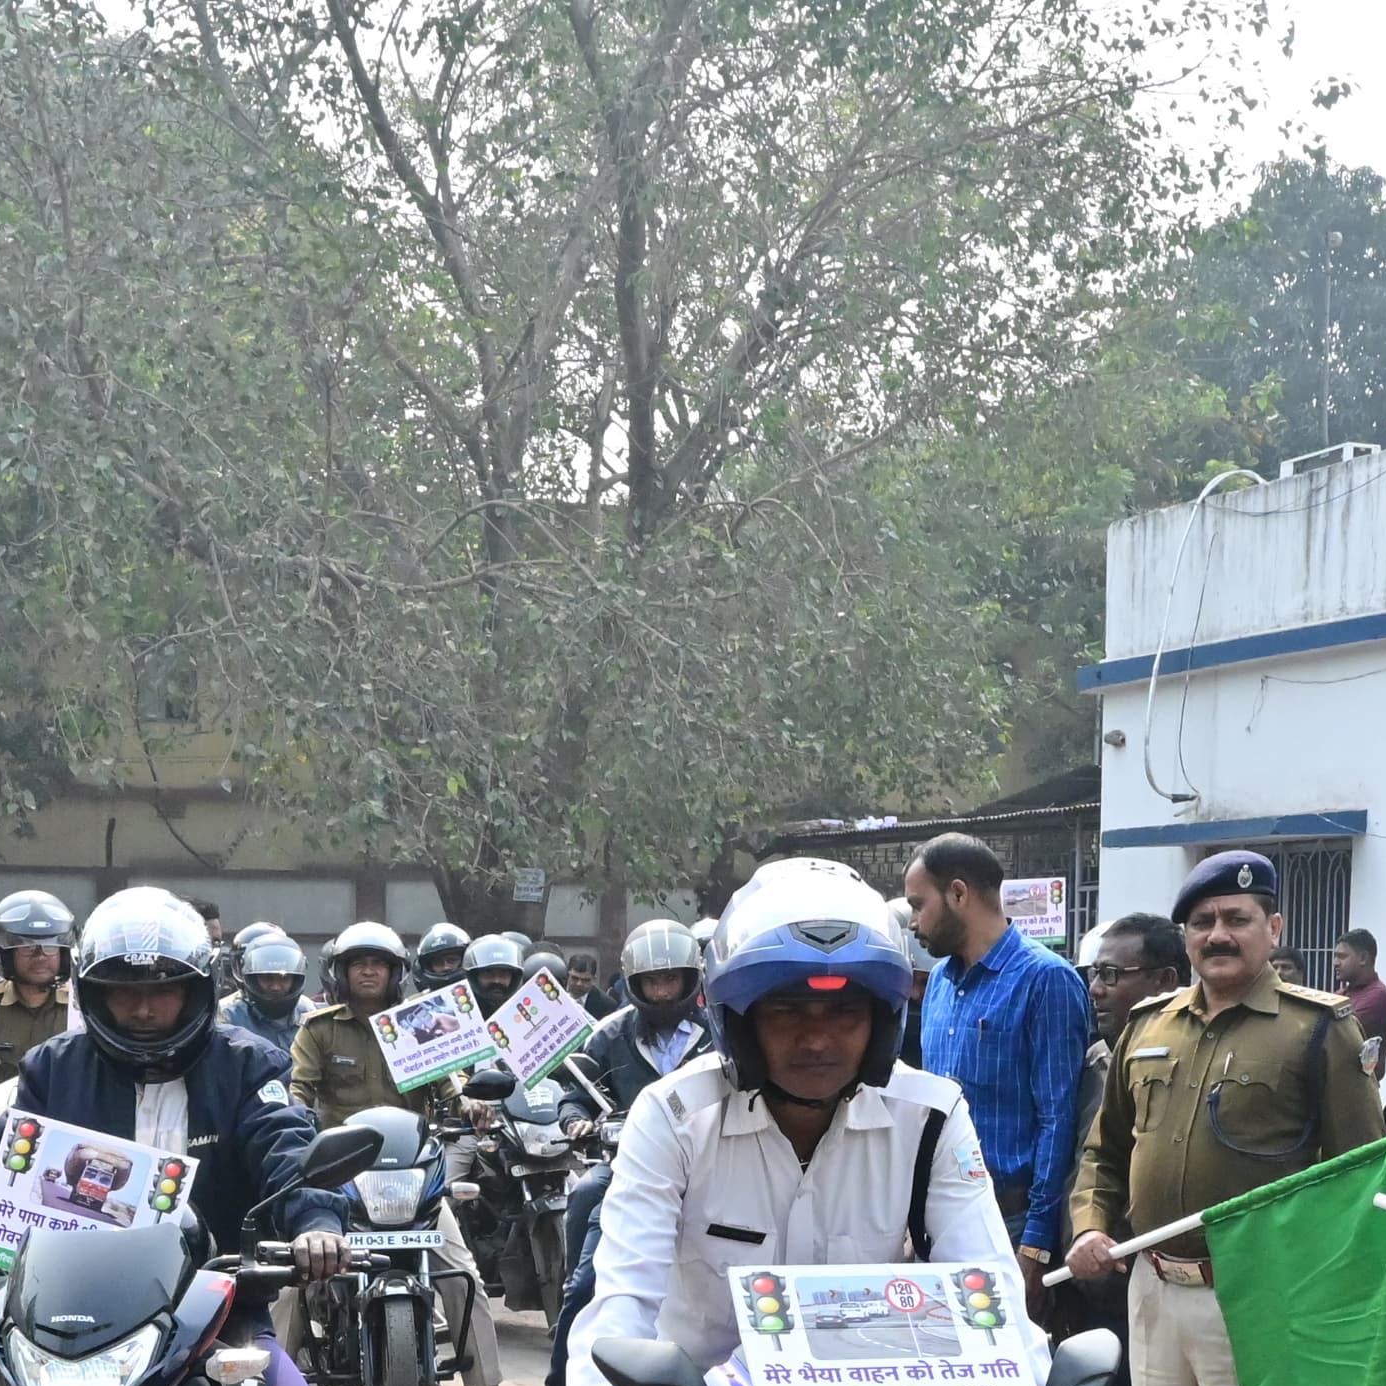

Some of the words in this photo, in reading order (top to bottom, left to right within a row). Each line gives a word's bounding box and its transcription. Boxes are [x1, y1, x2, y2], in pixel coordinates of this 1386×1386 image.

[18, 1208, 46, 1228] पापा
[892, 1283, 912, 1295] 120
[900, 1296, 915, 1308] 80
[51, 1314, 94, 1323] HONDA
[764, 1363, 793, 1385] मेरे
[797, 1361, 842, 1384] भैया
[846, 1365, 899, 1385] वाहन
[904, 1359, 934, 1381] को
[941, 1358, 975, 1380] तेज
[981, 1358, 1021, 1379] गति
